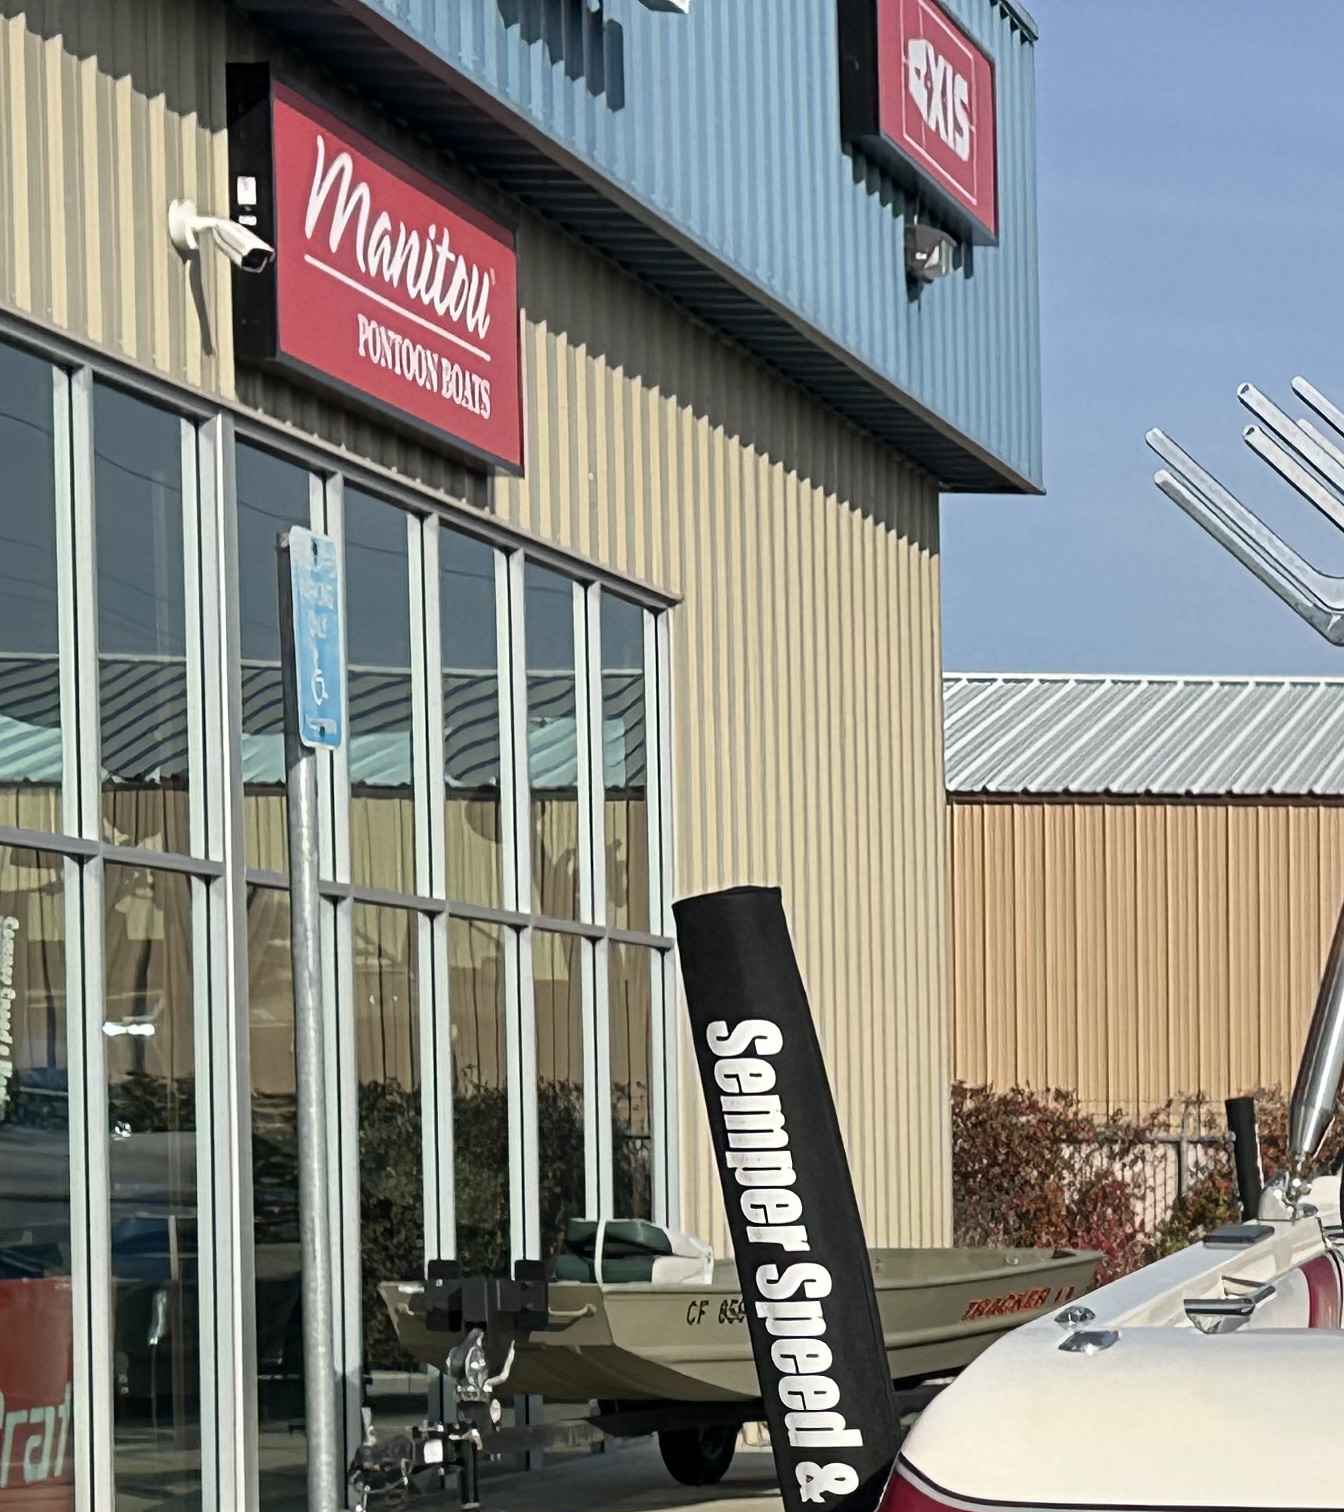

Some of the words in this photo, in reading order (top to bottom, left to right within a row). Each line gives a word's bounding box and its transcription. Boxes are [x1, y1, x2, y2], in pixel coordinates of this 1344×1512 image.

[304, 134, 492, 339] Manitou
[356, 312, 439, 393] PONTOON
[440, 355, 492, 421] BOATS
[704, 1017, 812, 1253] Semper
[686, 1299, 709, 1326] CF
[754, 1261, 865, 1449] Speed
[793, 1459, 861, 1505] &
